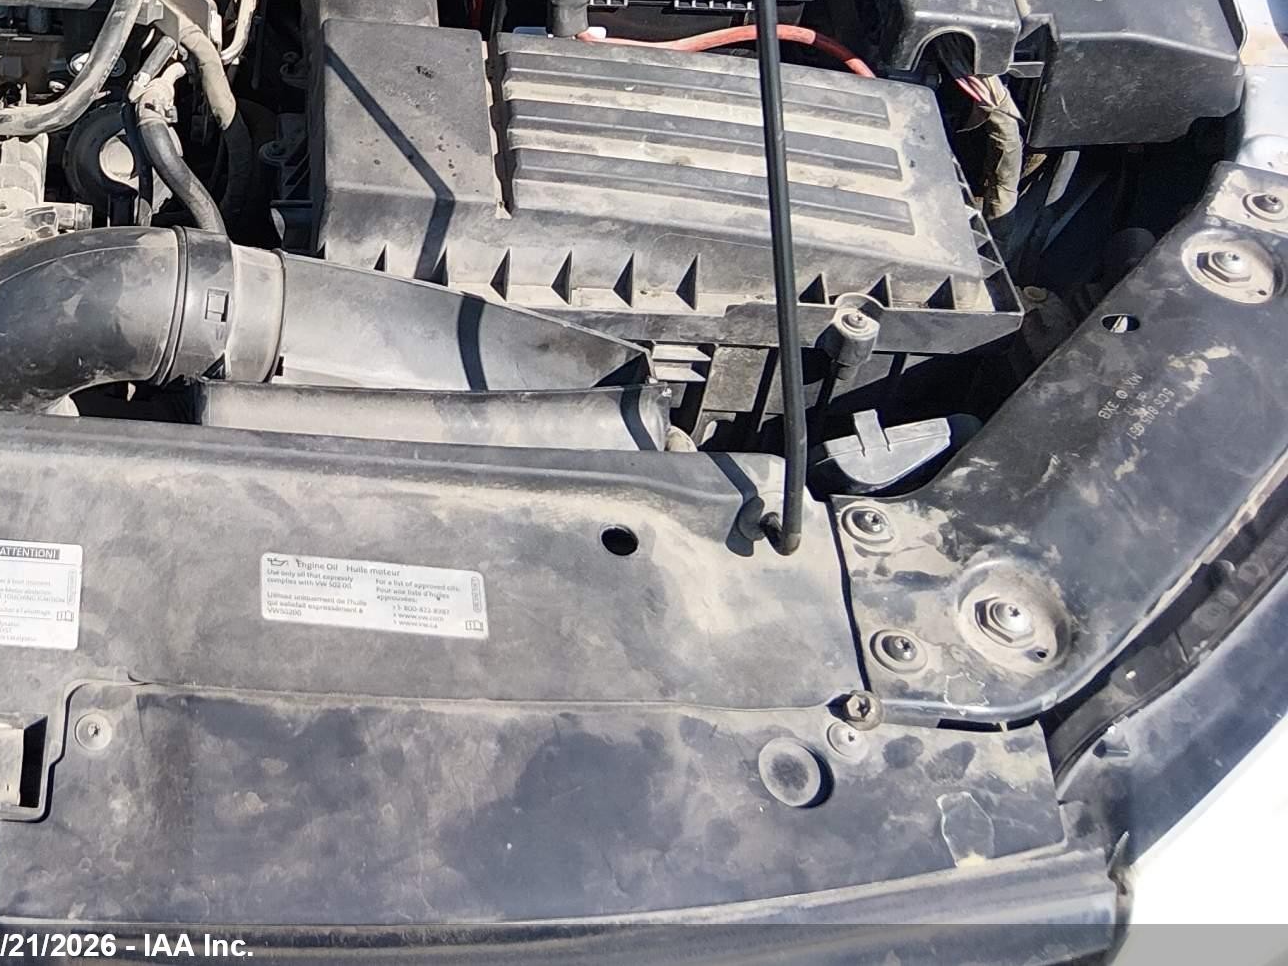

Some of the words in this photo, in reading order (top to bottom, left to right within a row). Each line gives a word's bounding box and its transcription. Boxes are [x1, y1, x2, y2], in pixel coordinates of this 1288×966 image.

[0, 545, 56, 558] ATTENTION!
[296, 559, 325, 571] Engine
[326, 563, 338, 571] Oil
[346, 565, 368, 574] Huile
[369, 568, 400, 576] moteur
